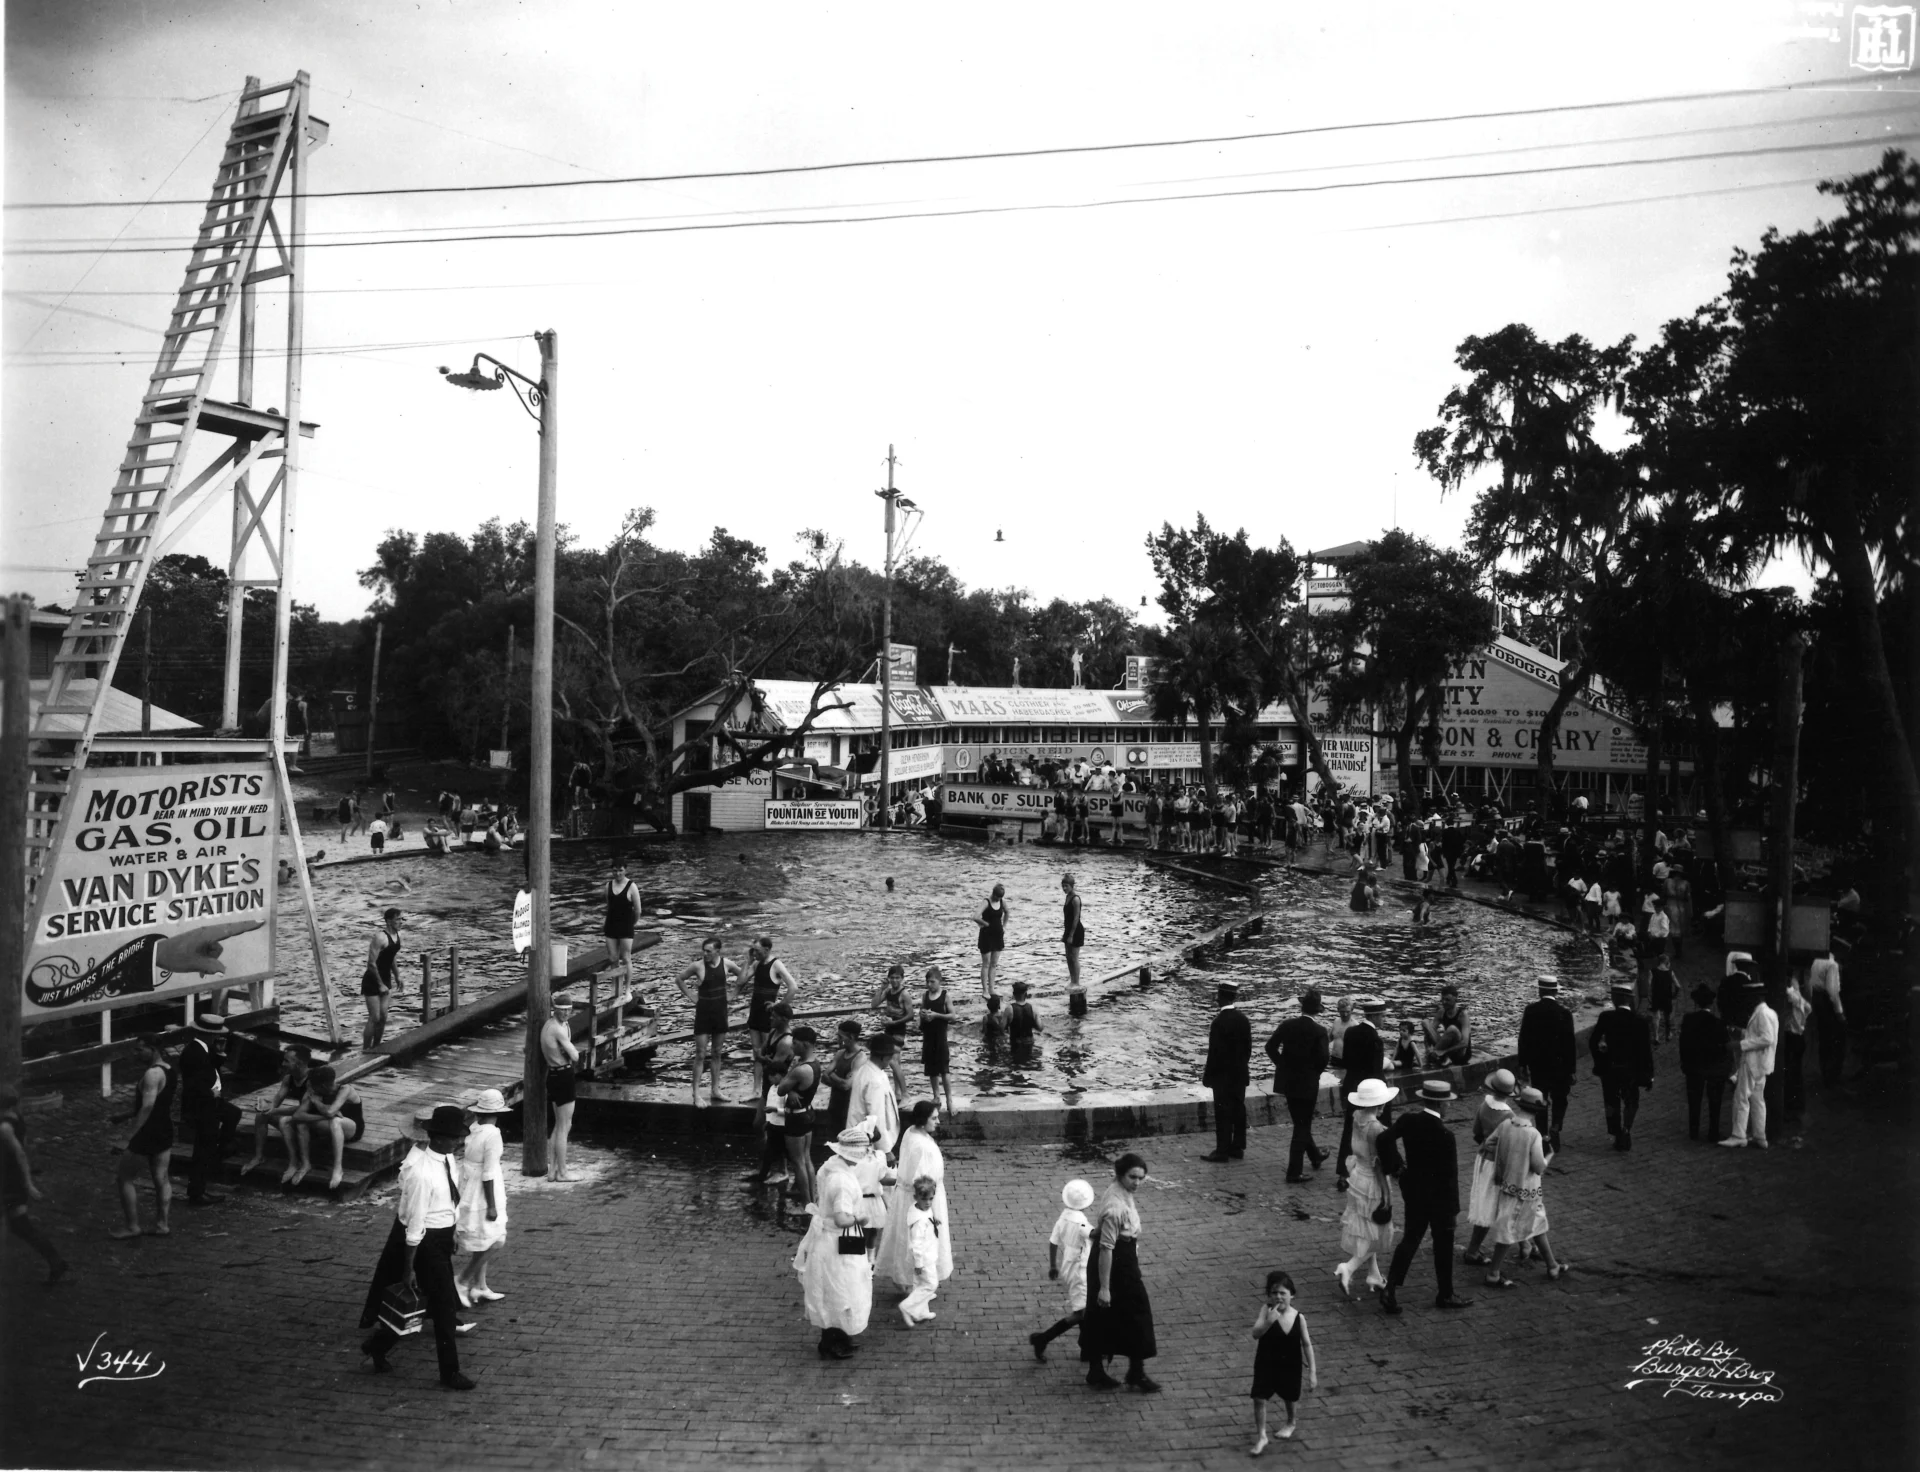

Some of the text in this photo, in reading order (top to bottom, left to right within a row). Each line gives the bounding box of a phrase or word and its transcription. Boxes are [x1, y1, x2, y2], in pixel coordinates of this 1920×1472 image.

[1486, 645, 1560, 687] TOBOGGA
[947, 700, 1007, 716] MAAS
[1007, 700, 1050, 708] CLOTHIER
[1011, 708, 1072, 716] HABERDASHER
[1504, 709, 1520, 717] TO
[1526, 709, 1580, 718] $10.00
[1340, 740, 1370, 753] VALUES
[1486, 728, 1503, 748] &
[1515, 728, 1602, 751] CRARY
[992, 746, 1073, 755] DICK REID
[1491, 751, 1524, 759] PHONE
[1325, 759, 1367, 772] CHANDISE
[746, 776, 772, 786] NOT!
[84, 774, 263, 823] MOTORISTS
[948, 790, 1146, 813] BANK OF SULP SPNG
[153, 804, 268, 820] BEAR IN MIND YOU MAY NEED
[767, 808, 859, 819] FOUNTAIN OF YOUTH
[194, 817, 267, 841] OIL
[110, 846, 227, 867] WATER & AIR
[63, 853, 261, 907] VAN DYKE'S
[46, 888, 264, 938] SERVICE STATION
[38, 938, 146, 1003] JUST ACROSS THE BRIDGE
